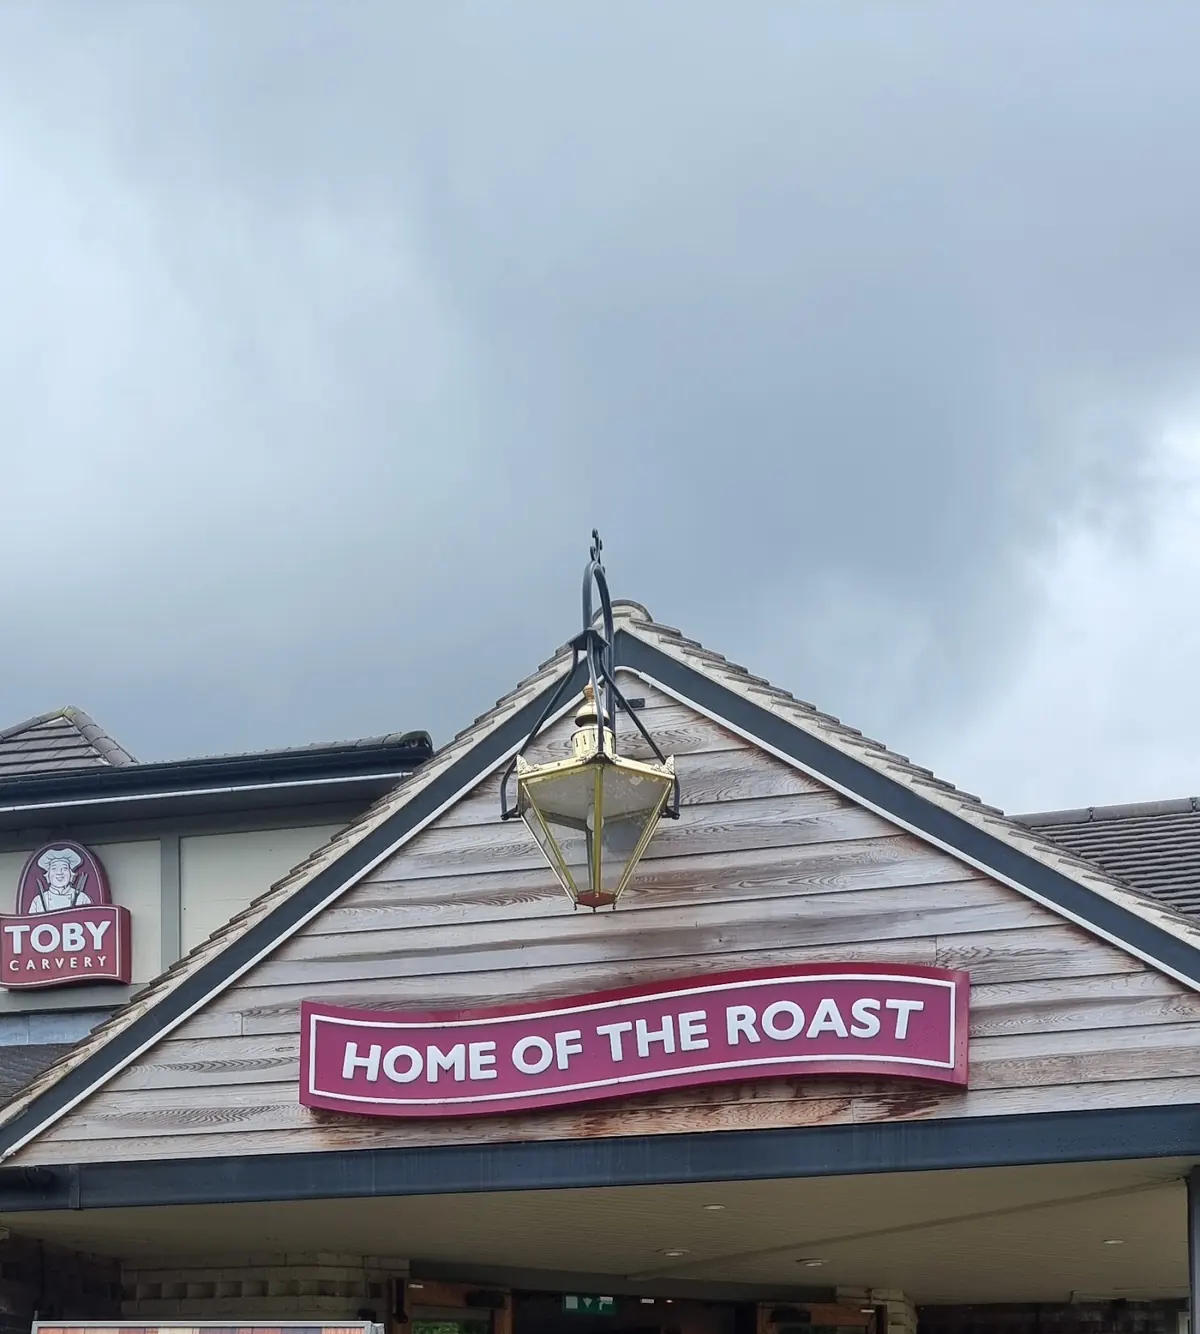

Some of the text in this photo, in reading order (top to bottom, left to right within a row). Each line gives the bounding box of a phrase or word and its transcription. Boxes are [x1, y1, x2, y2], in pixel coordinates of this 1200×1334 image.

[4, 920, 112, 954] TOBY
[9, 955, 108, 972] CARVERY
[342, 998, 924, 1083] HOME OF THE ROAST
